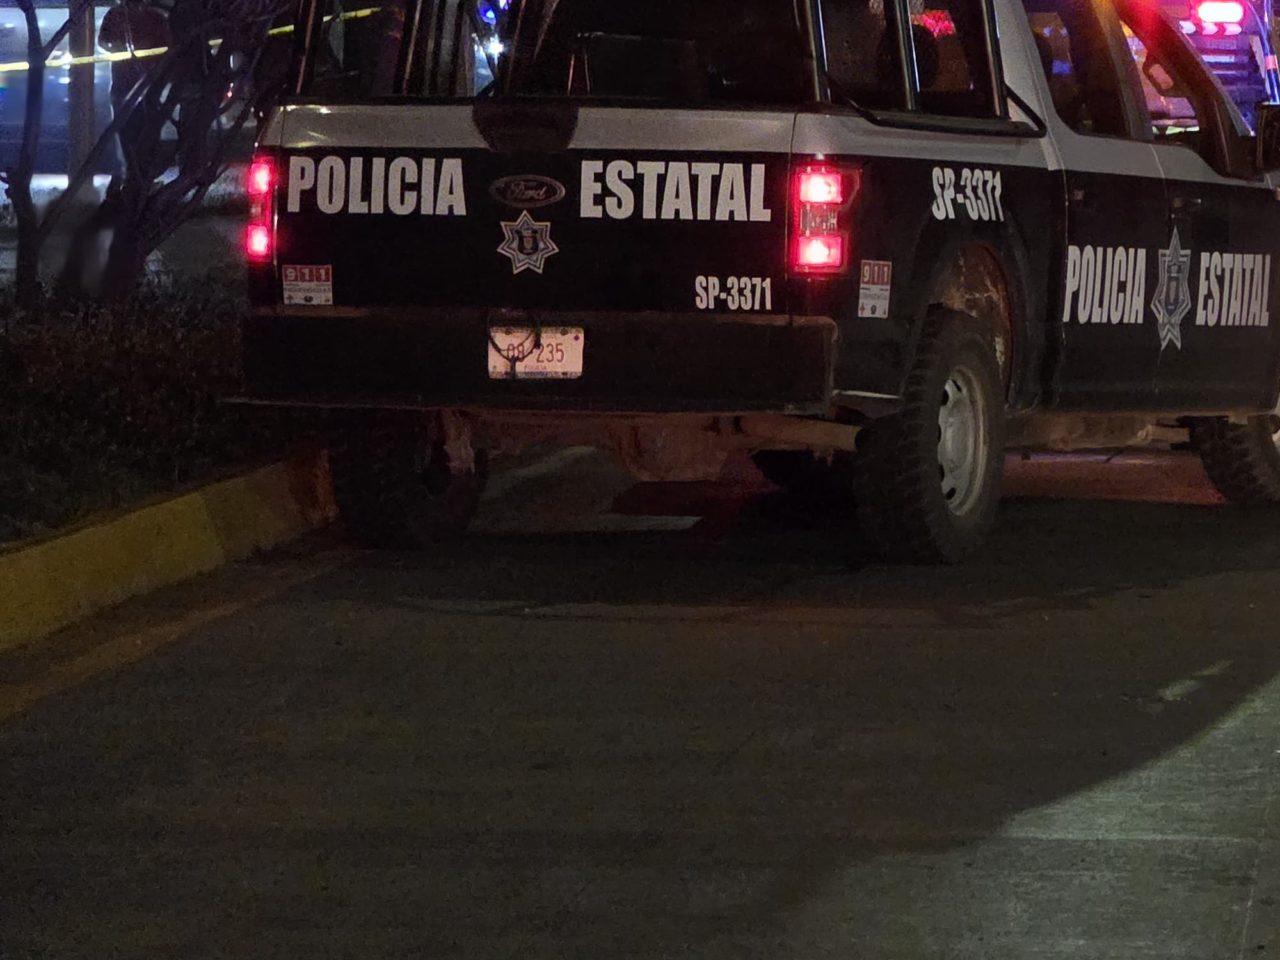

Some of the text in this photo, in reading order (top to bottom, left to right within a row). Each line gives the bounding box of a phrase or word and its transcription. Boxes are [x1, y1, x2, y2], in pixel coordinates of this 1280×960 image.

[287, 156, 771, 222] POLICIA ESTATAL
[507, 181, 548, 201] Ford
[932, 166, 1004, 222] SP-3371
[695, 275, 772, 311] SP-3371
[1063, 245, 1271, 327] POLICIA ESTATAL
